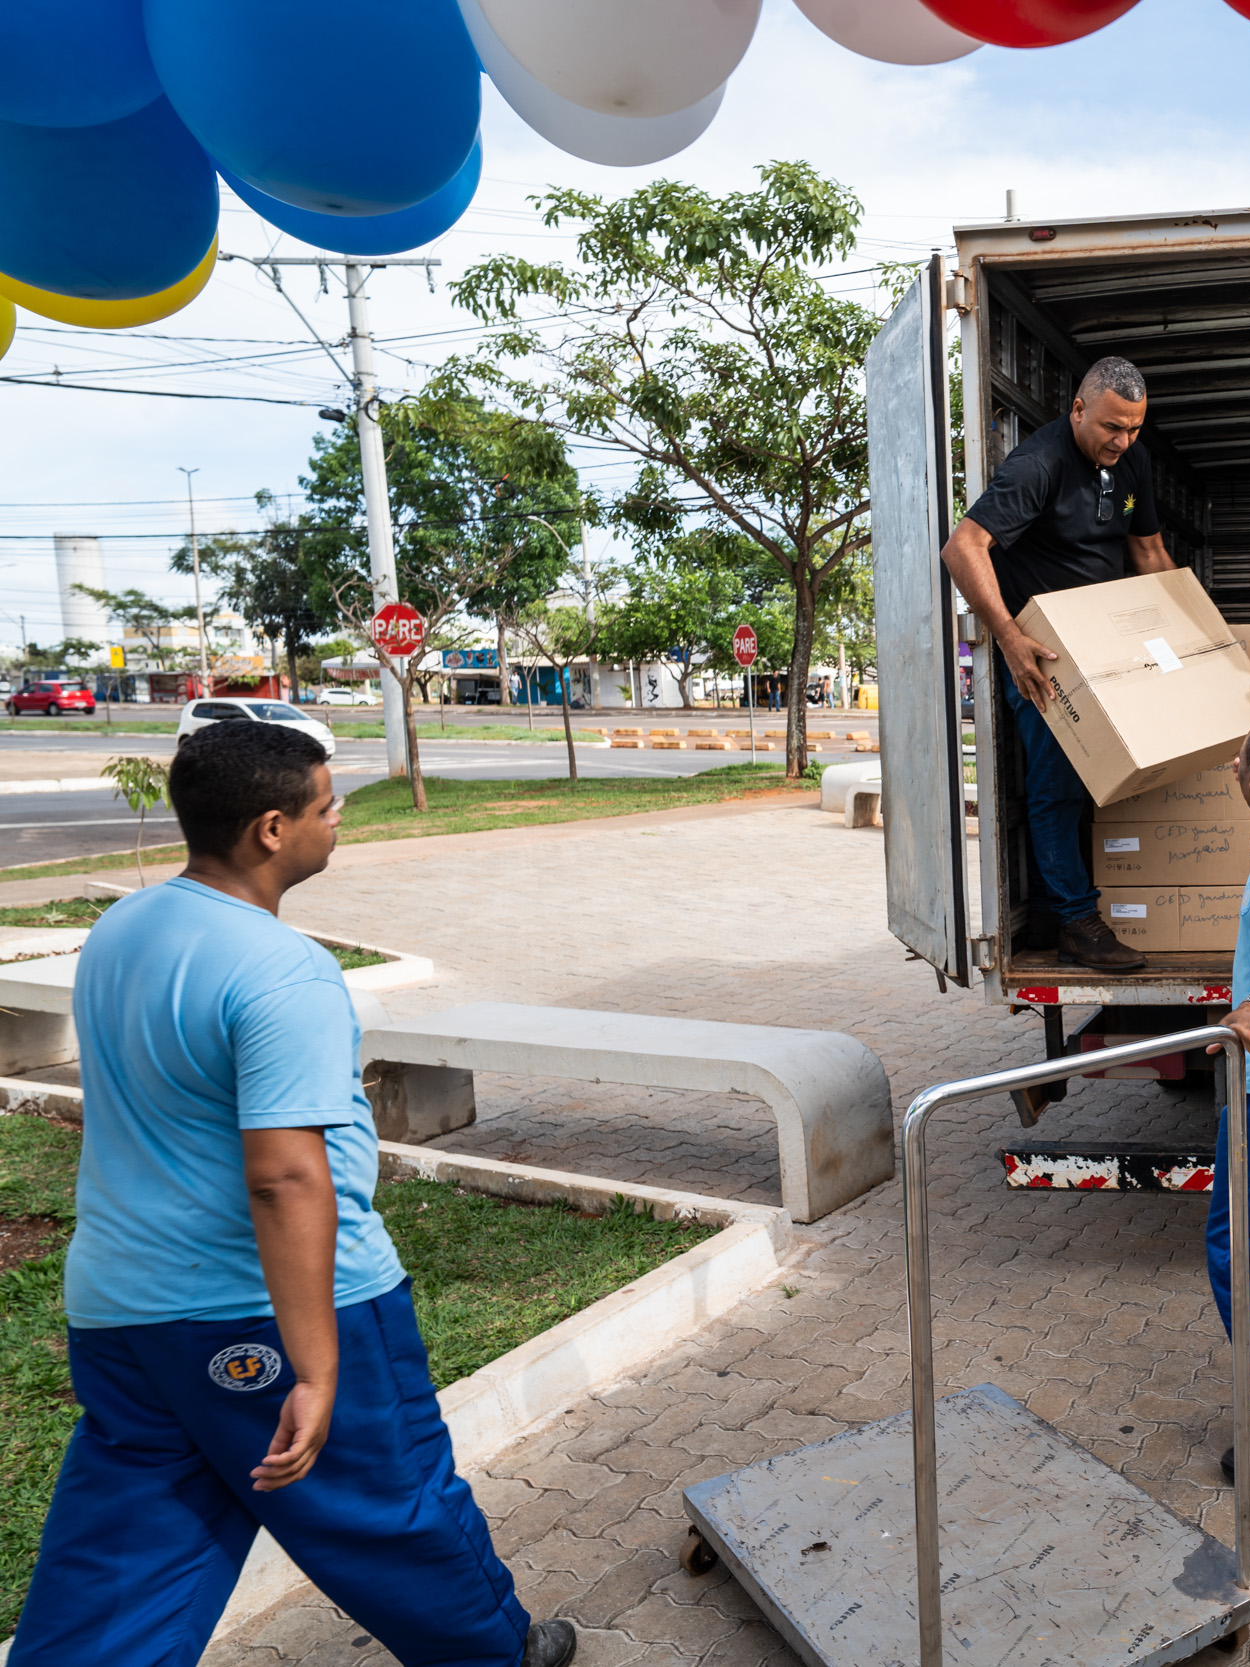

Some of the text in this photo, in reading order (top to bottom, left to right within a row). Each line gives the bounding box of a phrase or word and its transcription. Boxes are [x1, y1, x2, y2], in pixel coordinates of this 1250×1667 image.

[374, 619, 422, 640] PARE
[734, 637, 756, 654] PARE
[1050, 675, 1081, 724] POSITIVO
[1155, 894, 1191, 906] CED
[945, 1474, 972, 1497] Nitto
[855, 1497, 884, 1521] Nitto
[1029, 1544, 1056, 1570] Nitto
[1127, 1622, 1155, 1654] Nitto
